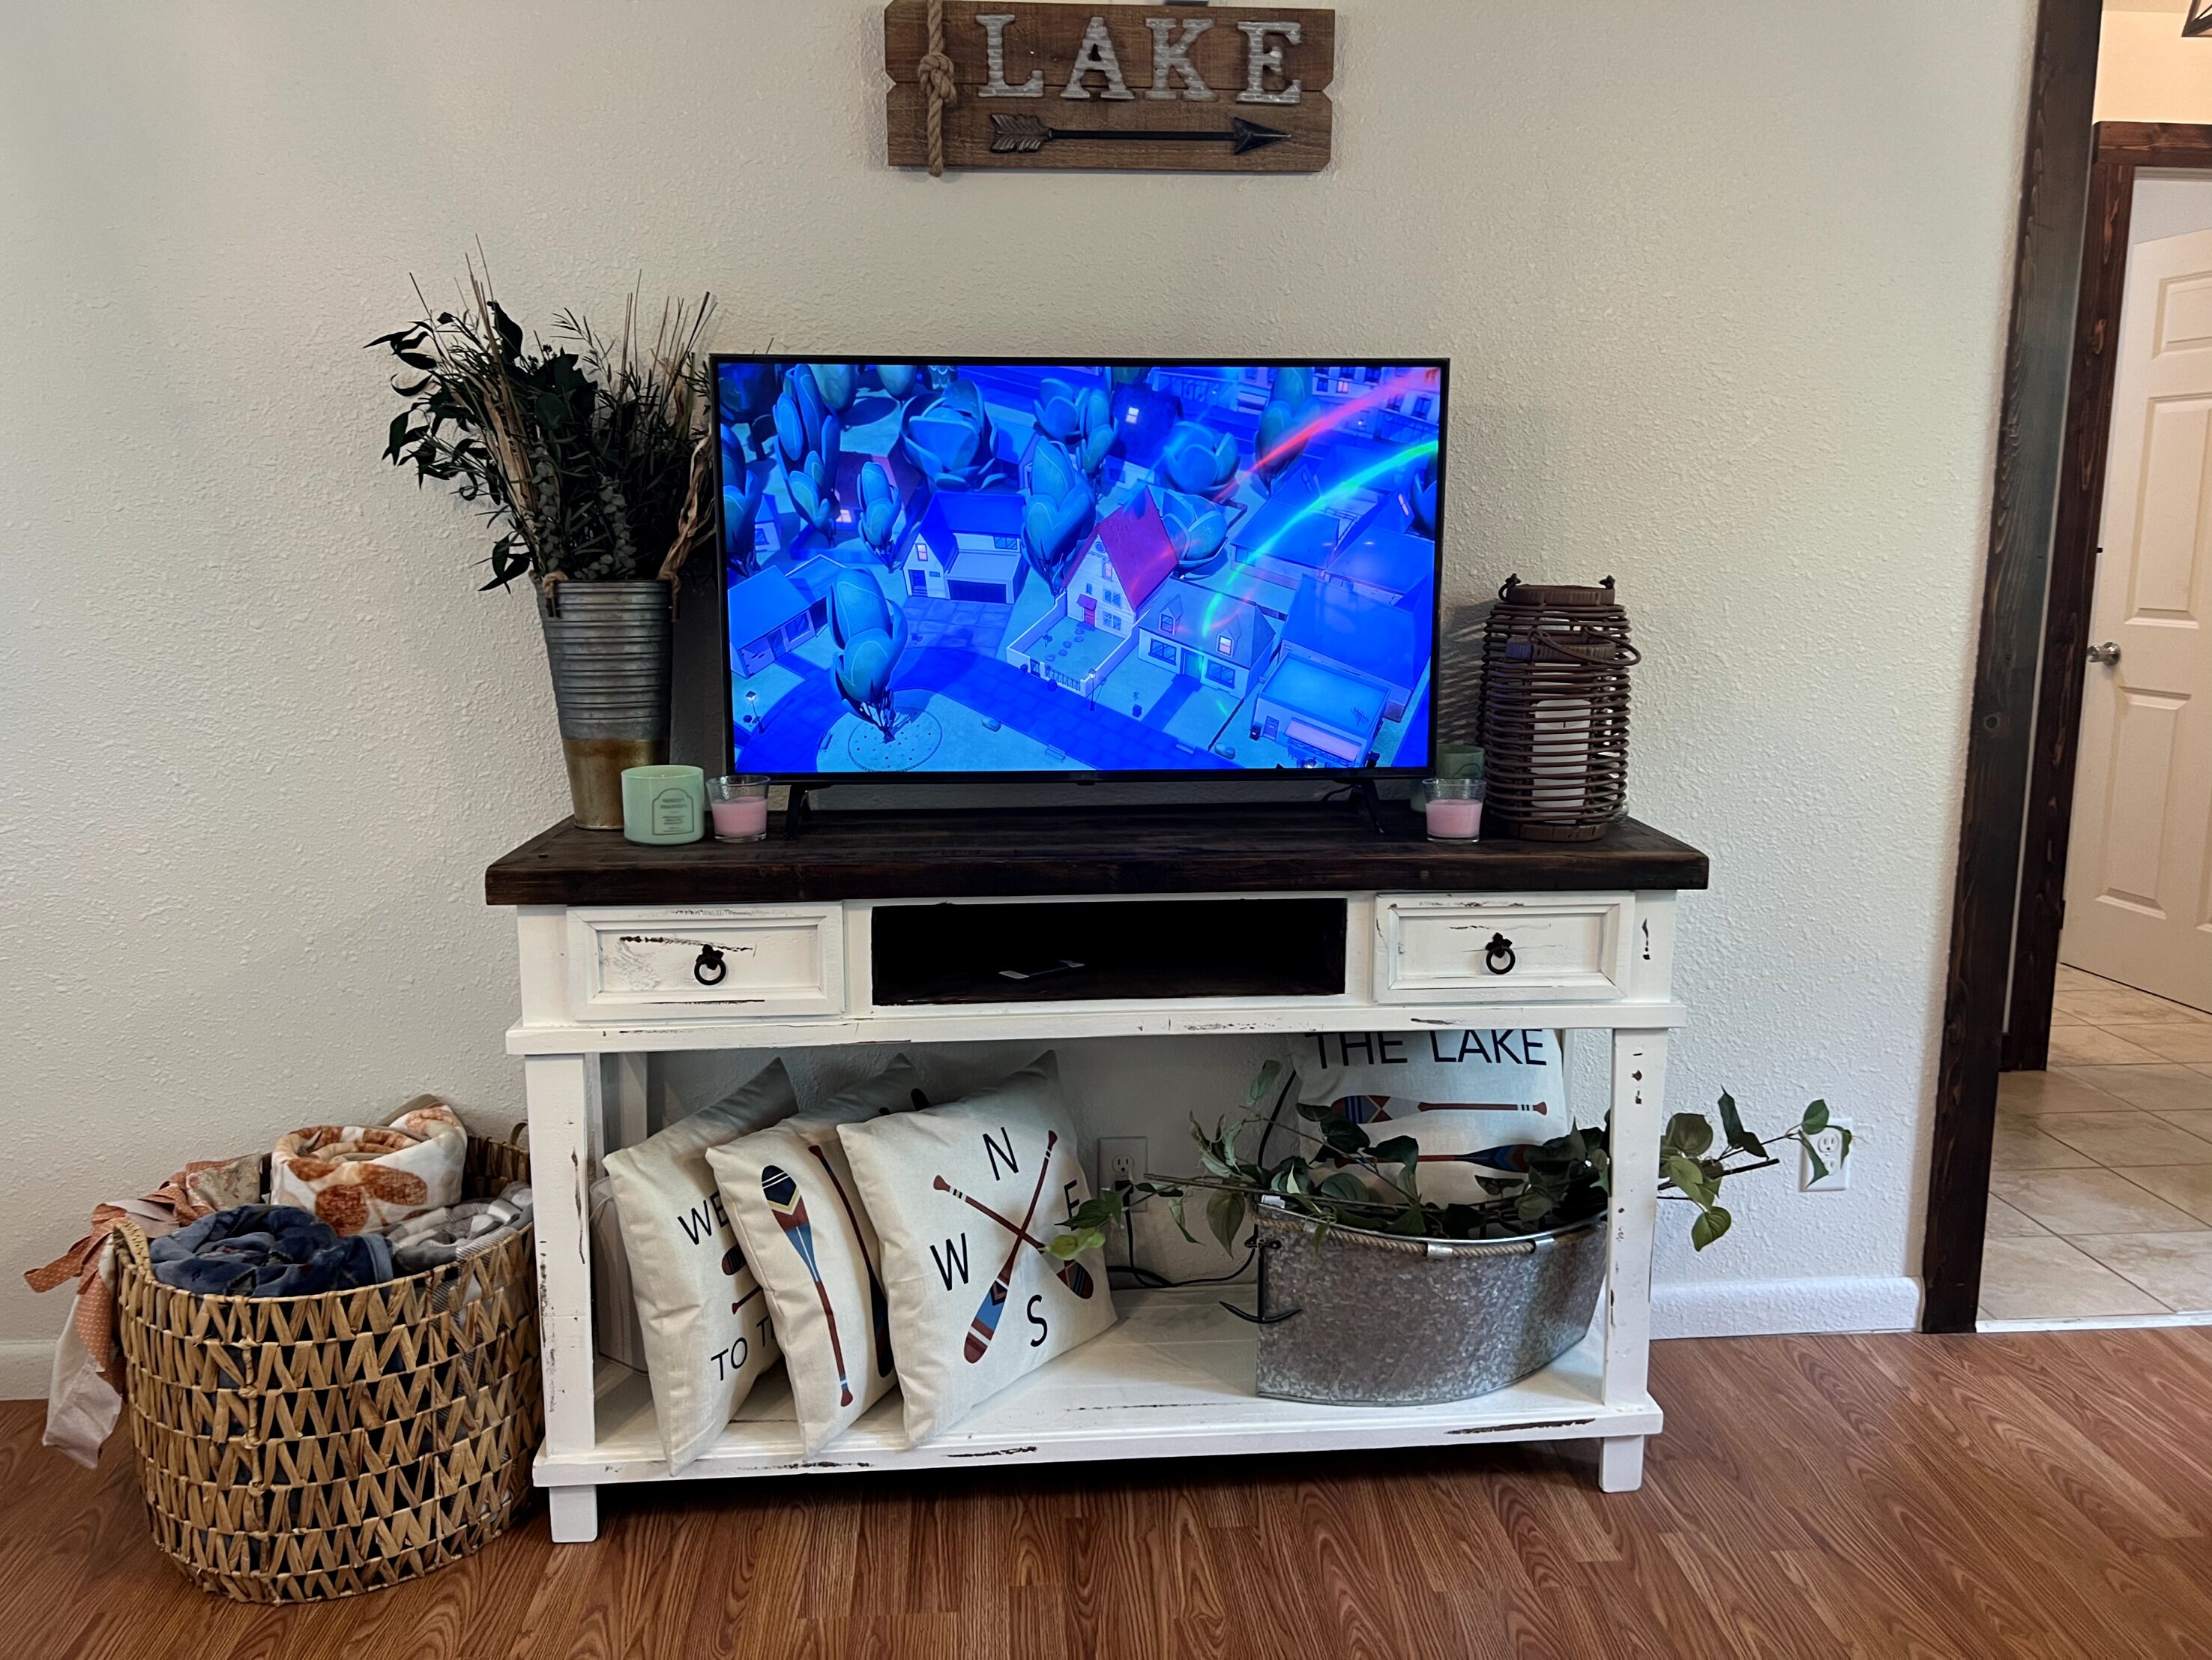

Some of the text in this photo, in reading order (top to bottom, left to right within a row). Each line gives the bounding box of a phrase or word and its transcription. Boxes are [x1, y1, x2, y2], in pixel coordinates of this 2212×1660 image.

[975, 13, 1303, 104] LAKE
[1304, 1029, 1547, 1069] THE LAKE
[982, 1126, 1019, 1181] N
[929, 1232, 969, 1291] W
[1026, 1294, 1048, 1347] S
[711, 1337, 748, 1381] TO
